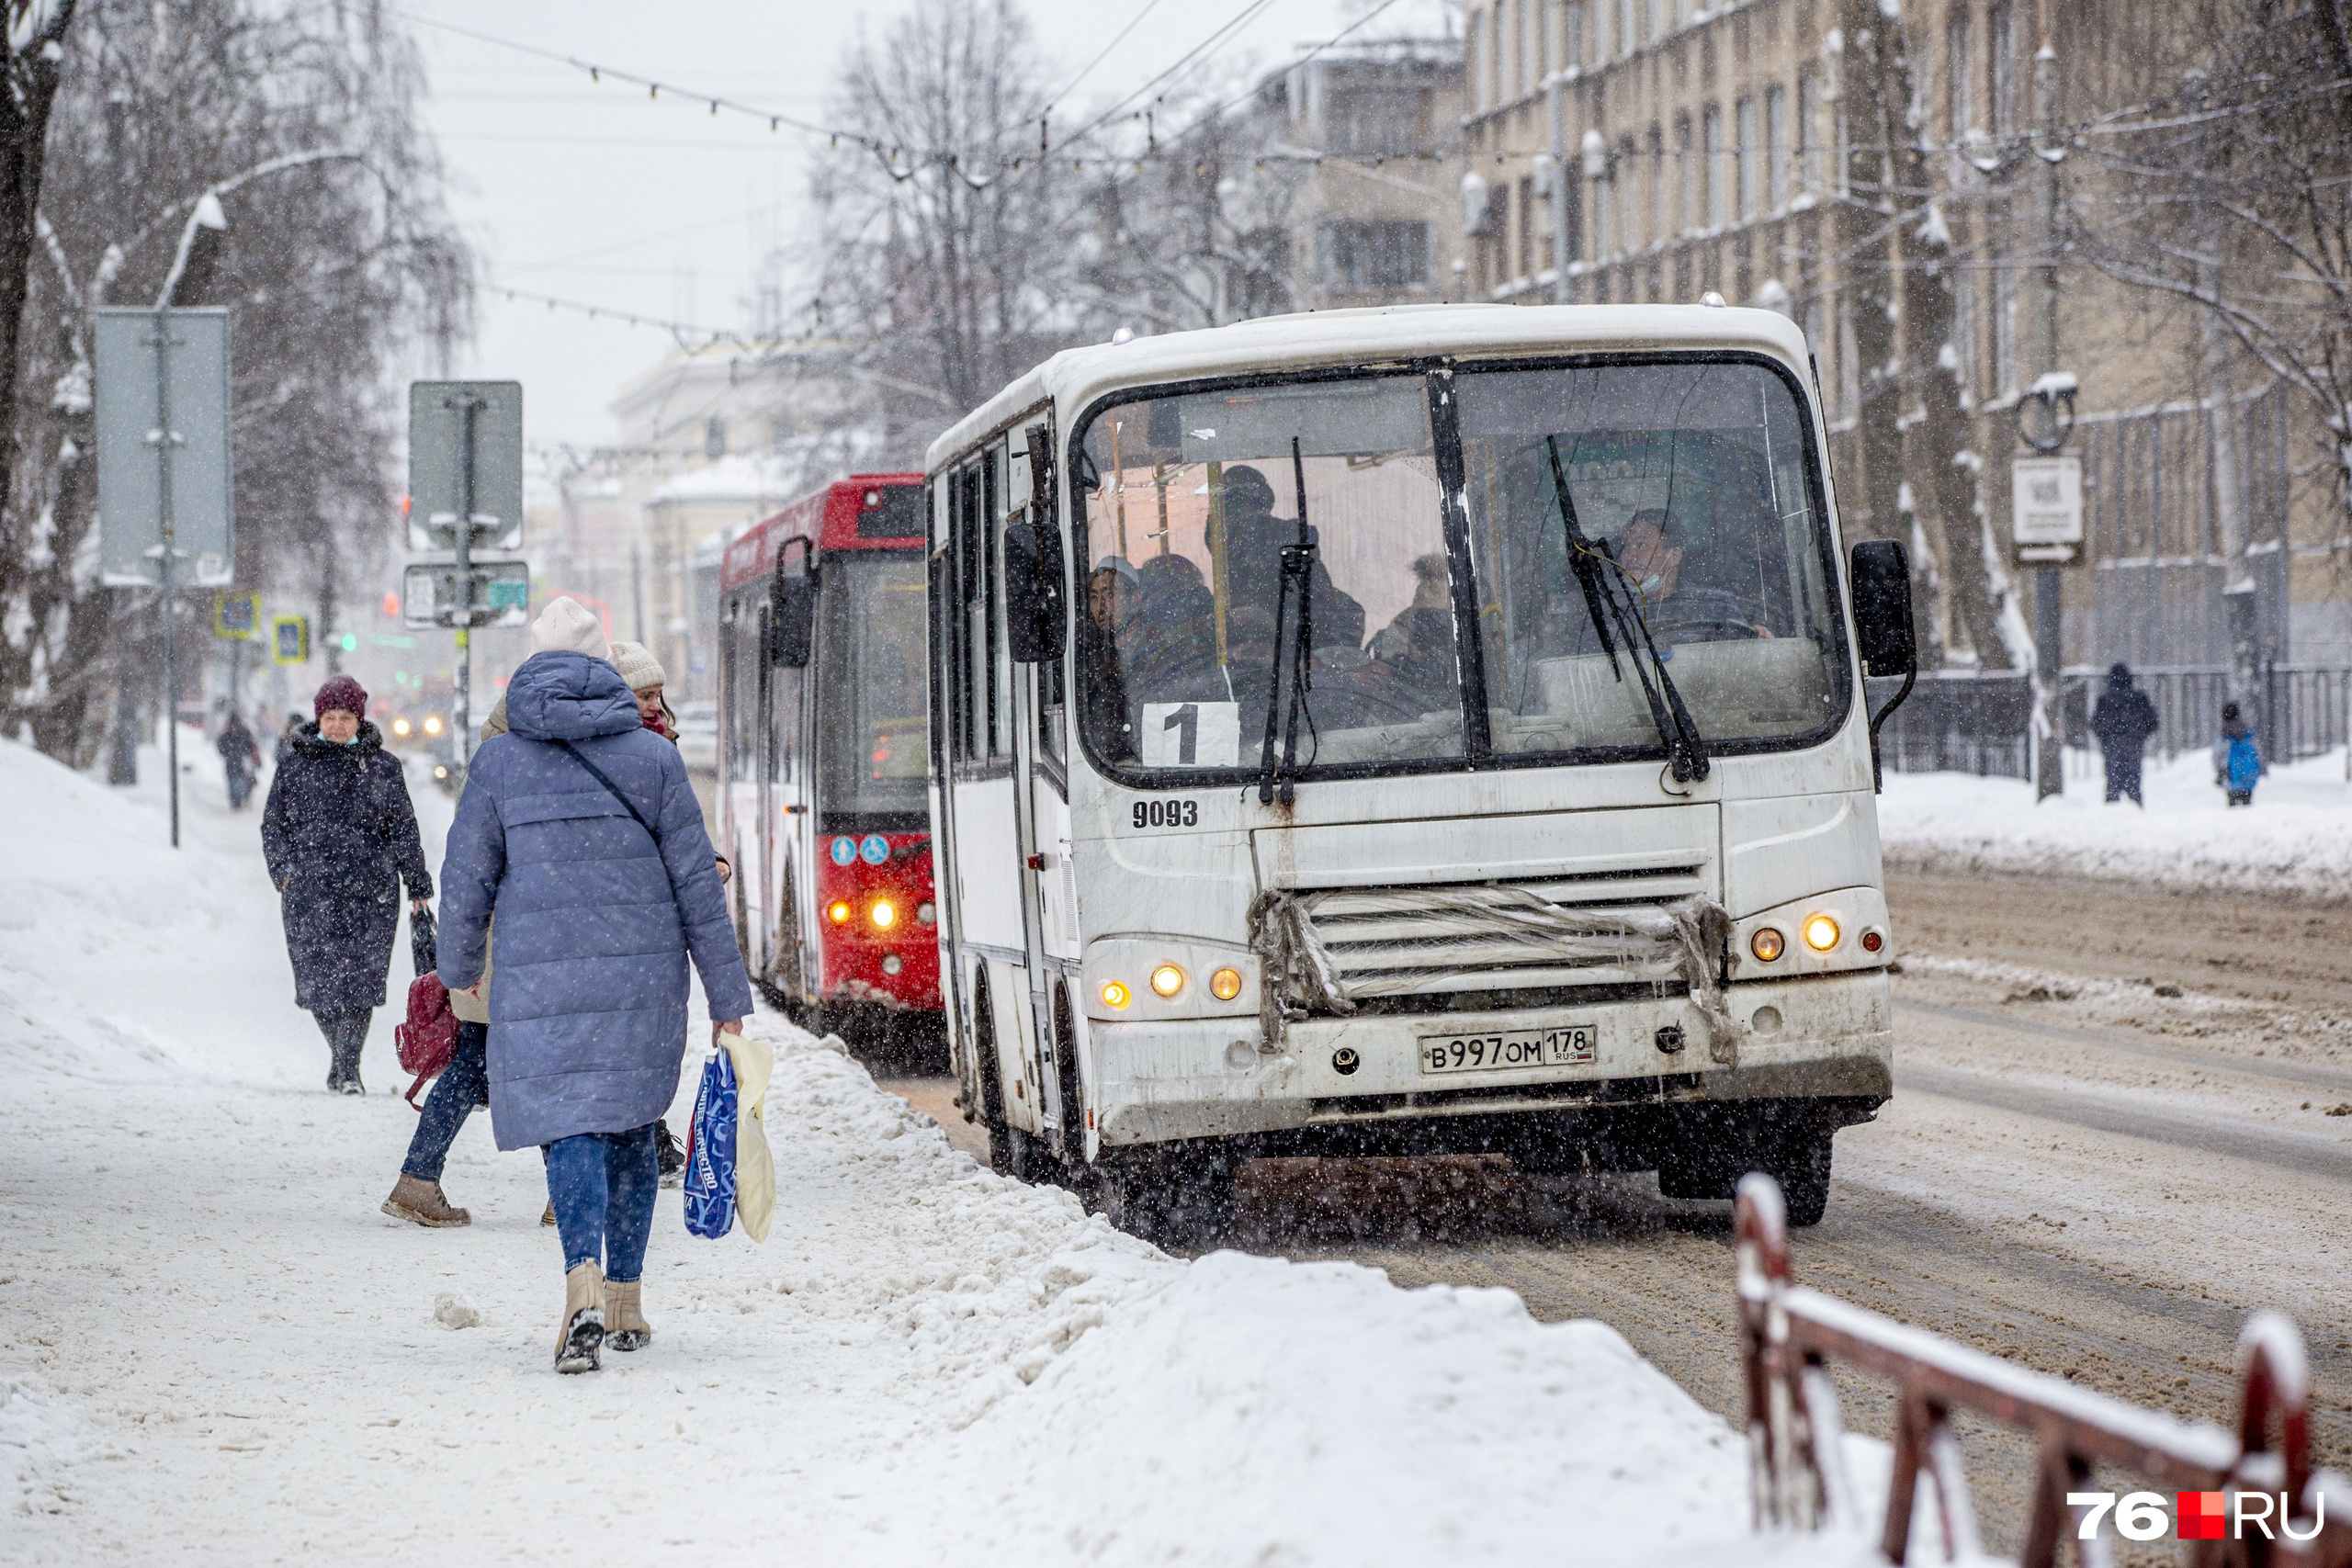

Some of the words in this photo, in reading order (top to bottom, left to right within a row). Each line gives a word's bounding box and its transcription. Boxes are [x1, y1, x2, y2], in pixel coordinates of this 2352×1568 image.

[1164, 704, 1198, 764] 1
[1133, 800, 1198, 829] 9093
[1546, 1031, 1587, 1053] 178
[1555, 1052, 1577, 1061] RUS
[696, 1126, 718, 1190] КАЧЕСТВО
